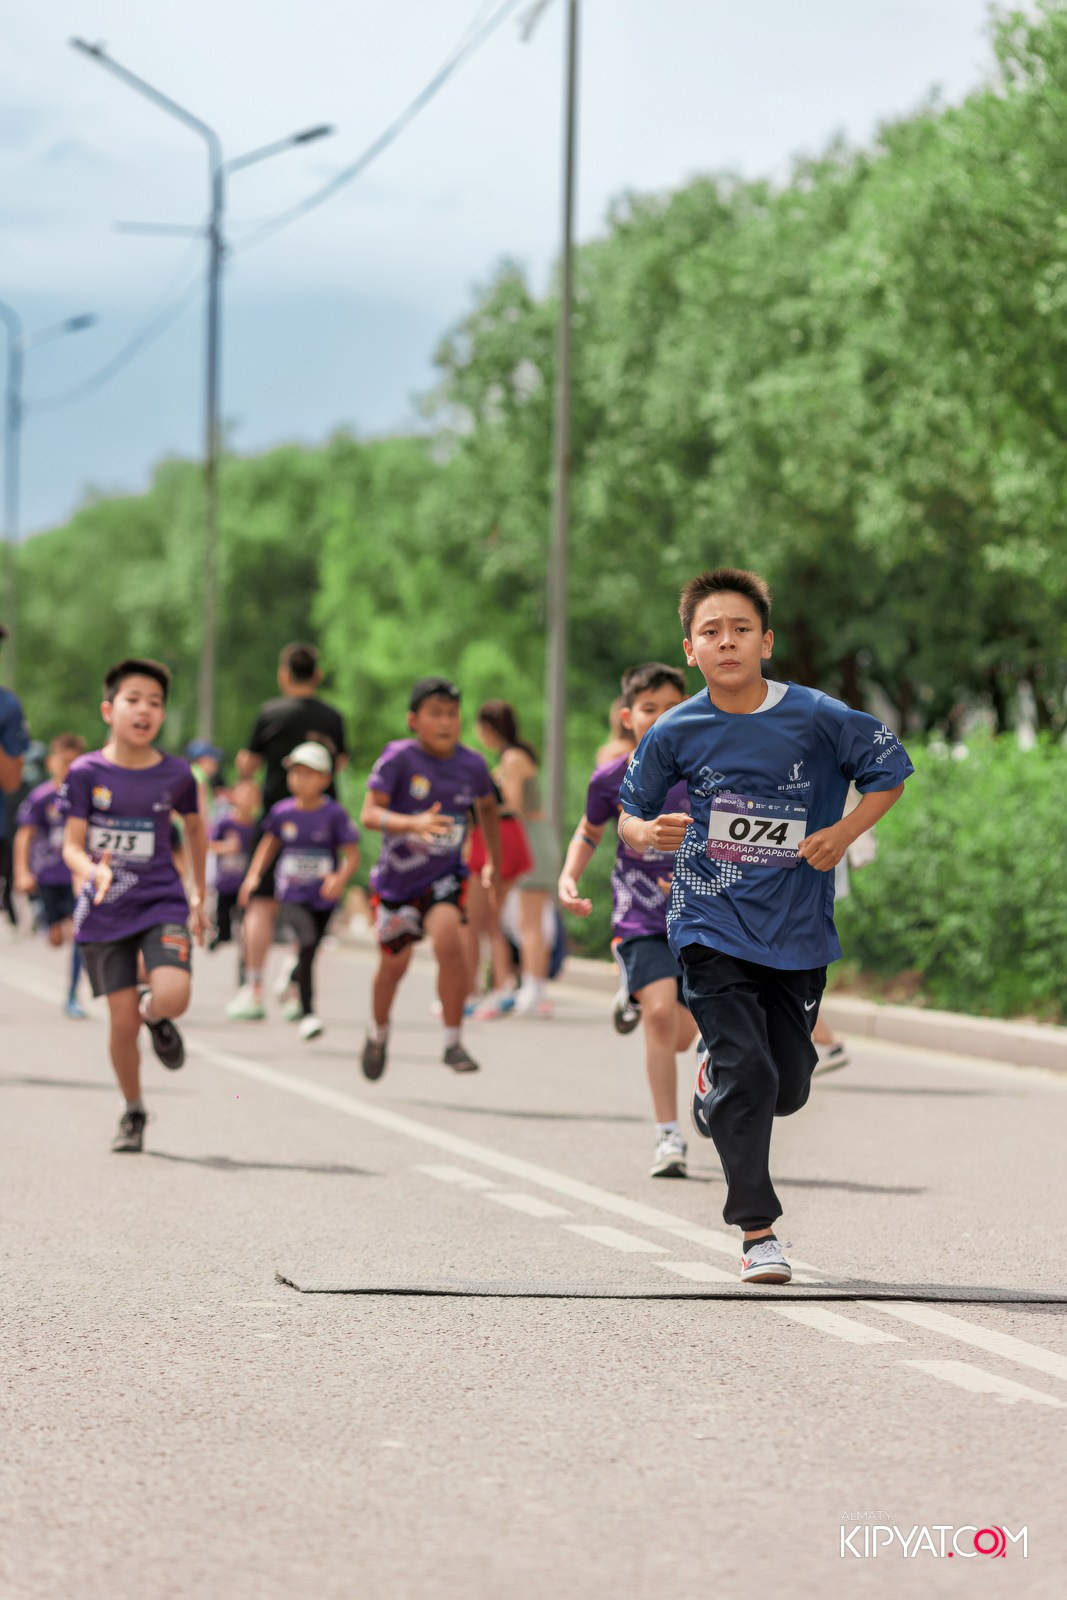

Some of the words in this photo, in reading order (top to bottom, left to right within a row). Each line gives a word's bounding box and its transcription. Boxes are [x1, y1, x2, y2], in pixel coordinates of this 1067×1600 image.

[729, 818, 789, 845] 074
[98, 833, 137, 851] 213
[711, 840, 754, 853] БАЛАЛАР
[740, 855, 760, 863] 600
